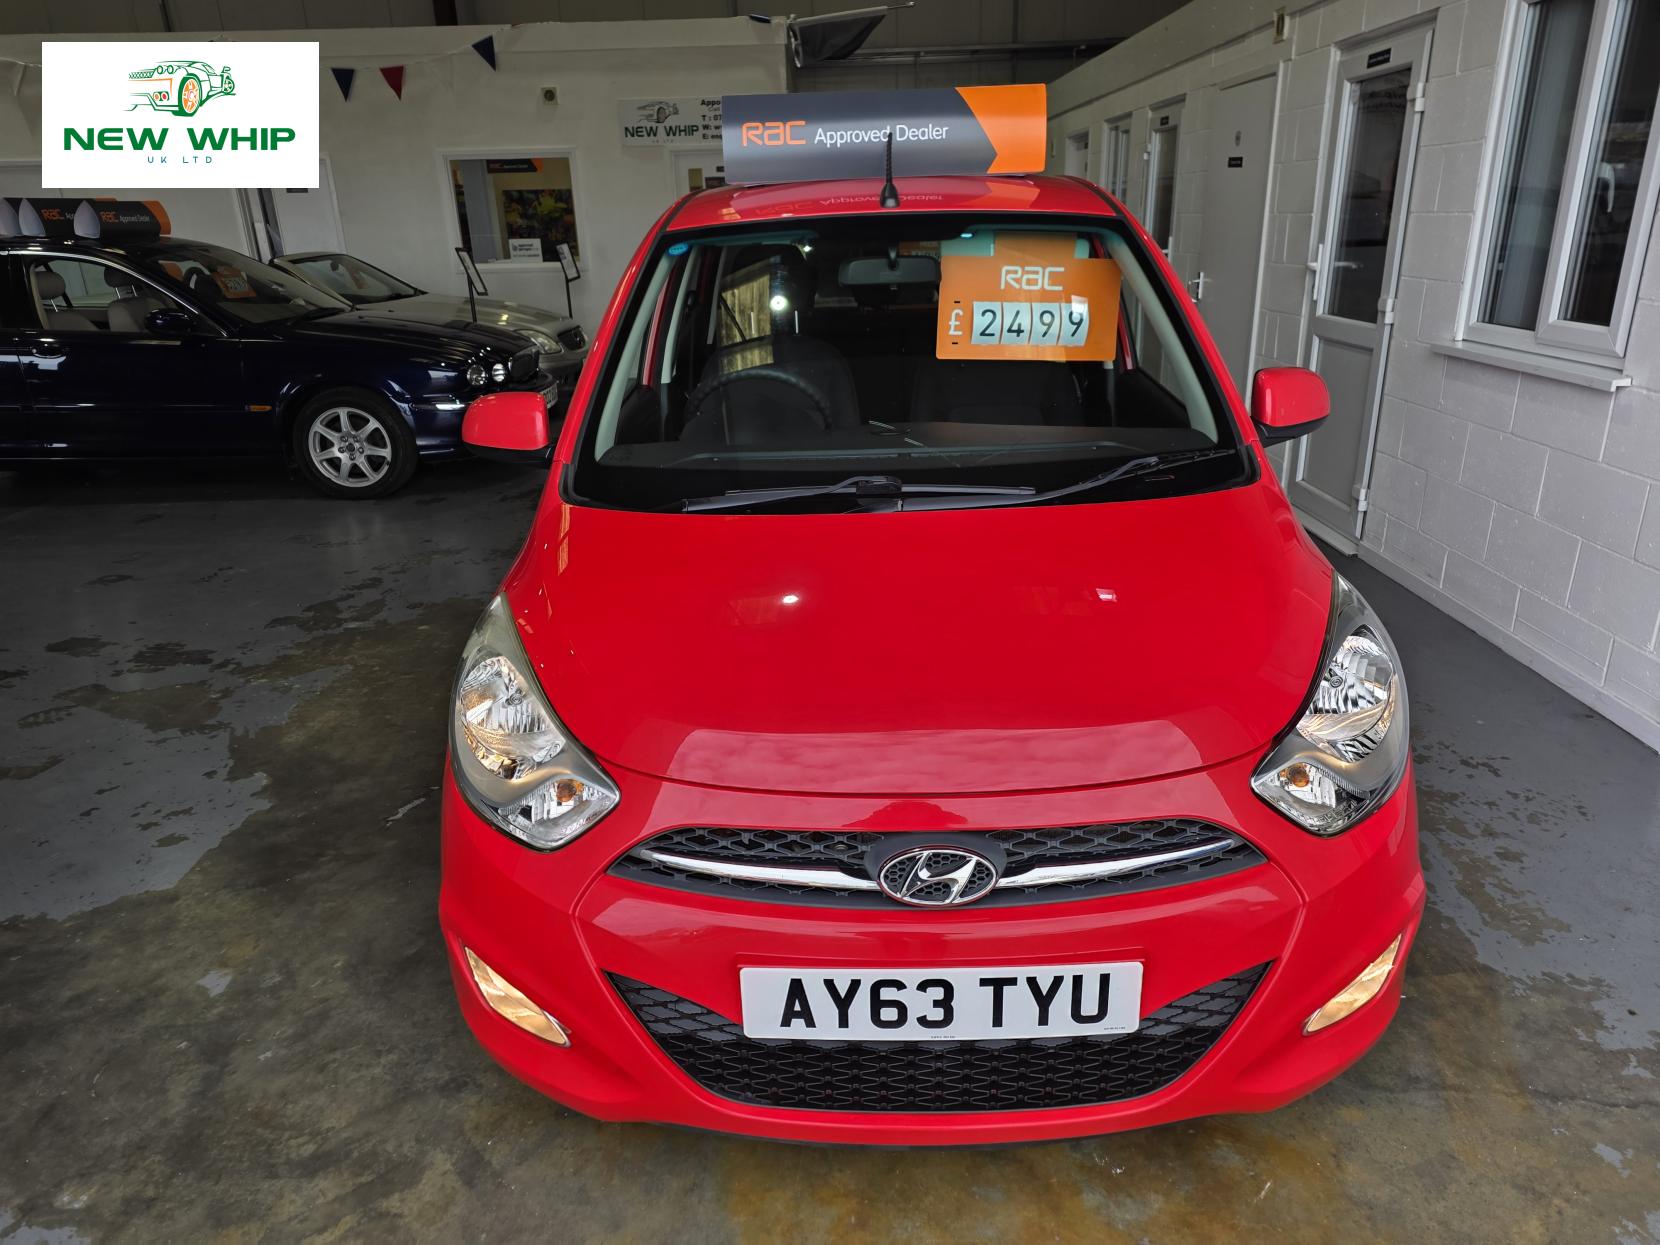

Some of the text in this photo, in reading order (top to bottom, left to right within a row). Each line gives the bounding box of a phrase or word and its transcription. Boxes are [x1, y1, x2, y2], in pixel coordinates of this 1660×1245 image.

[624, 125, 699, 138] NEW WHIP
[814, 124, 890, 148] Approved
[896, 123, 949, 141] Dealer
[780, 972, 1111, 1029] AY63 TYU
